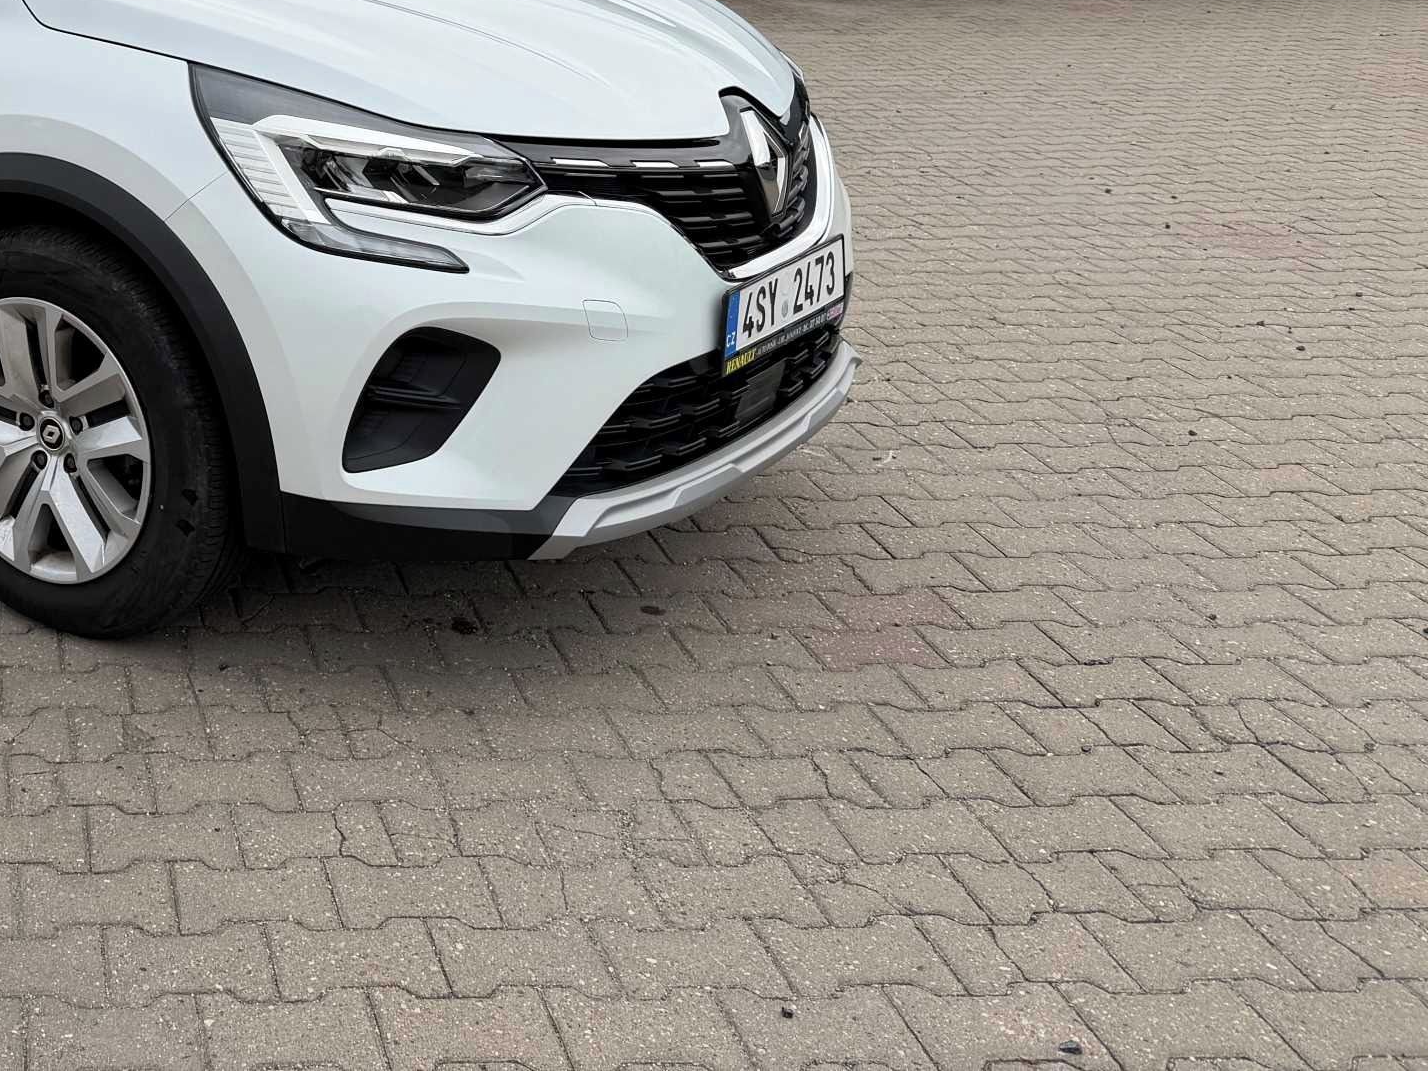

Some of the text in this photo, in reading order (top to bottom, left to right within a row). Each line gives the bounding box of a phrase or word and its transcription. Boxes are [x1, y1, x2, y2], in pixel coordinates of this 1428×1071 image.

[742, 277, 778, 338] 4SY
[793, 251, 835, 315] 2473
[726, 331, 736, 347] CZ
